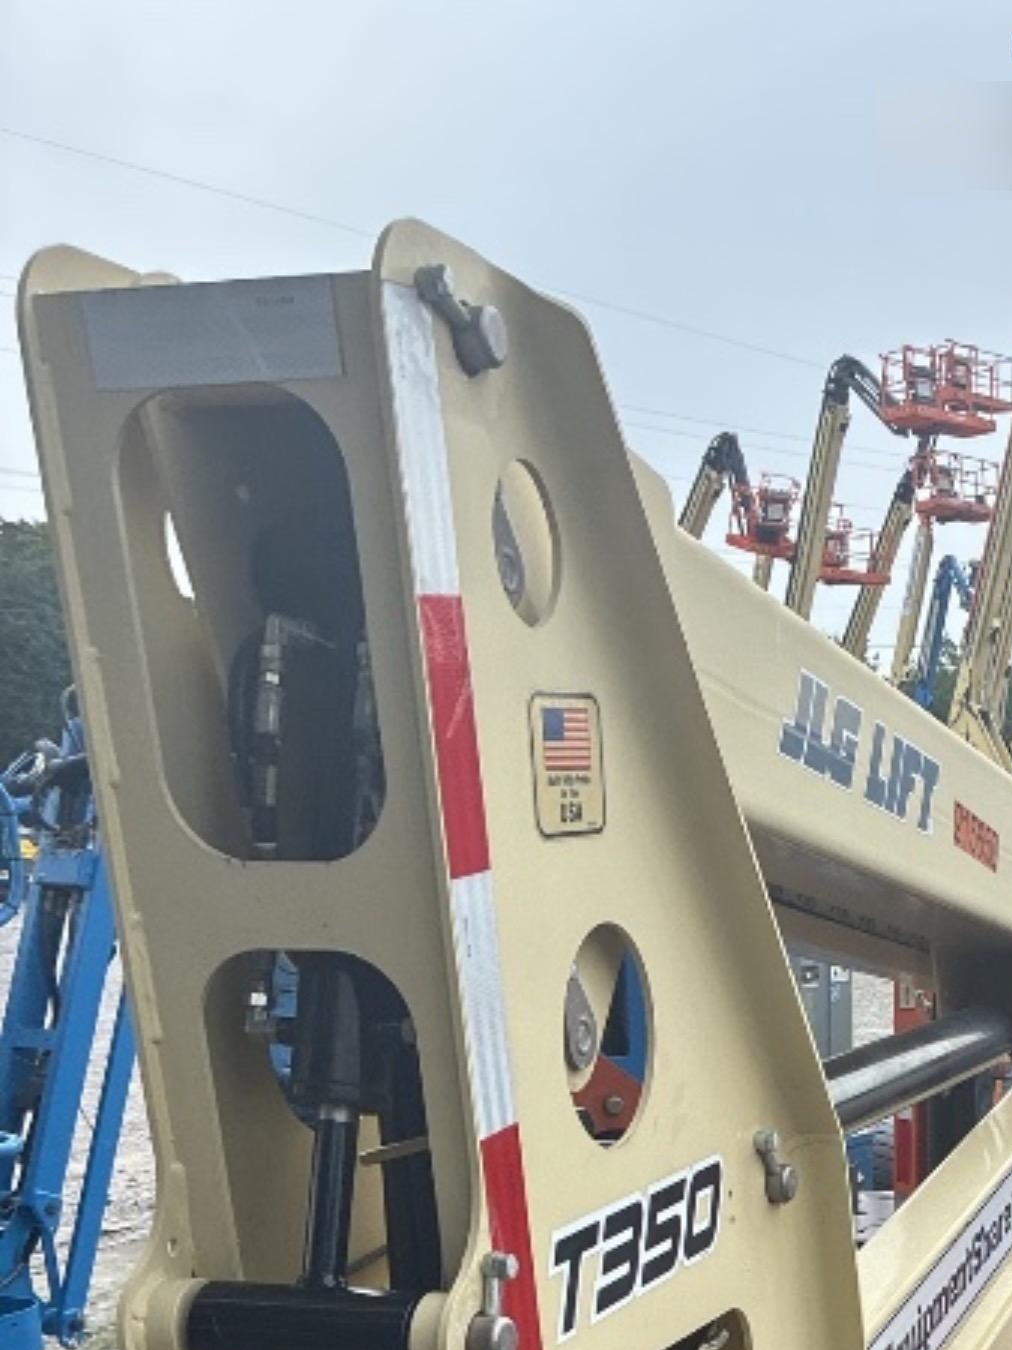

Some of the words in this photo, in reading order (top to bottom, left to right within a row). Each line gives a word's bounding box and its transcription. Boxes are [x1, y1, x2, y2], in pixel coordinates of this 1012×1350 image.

[778, 669, 862, 791] JLG
[864, 720, 941, 835] LIFT
[551, 1157, 723, 1340] T350
